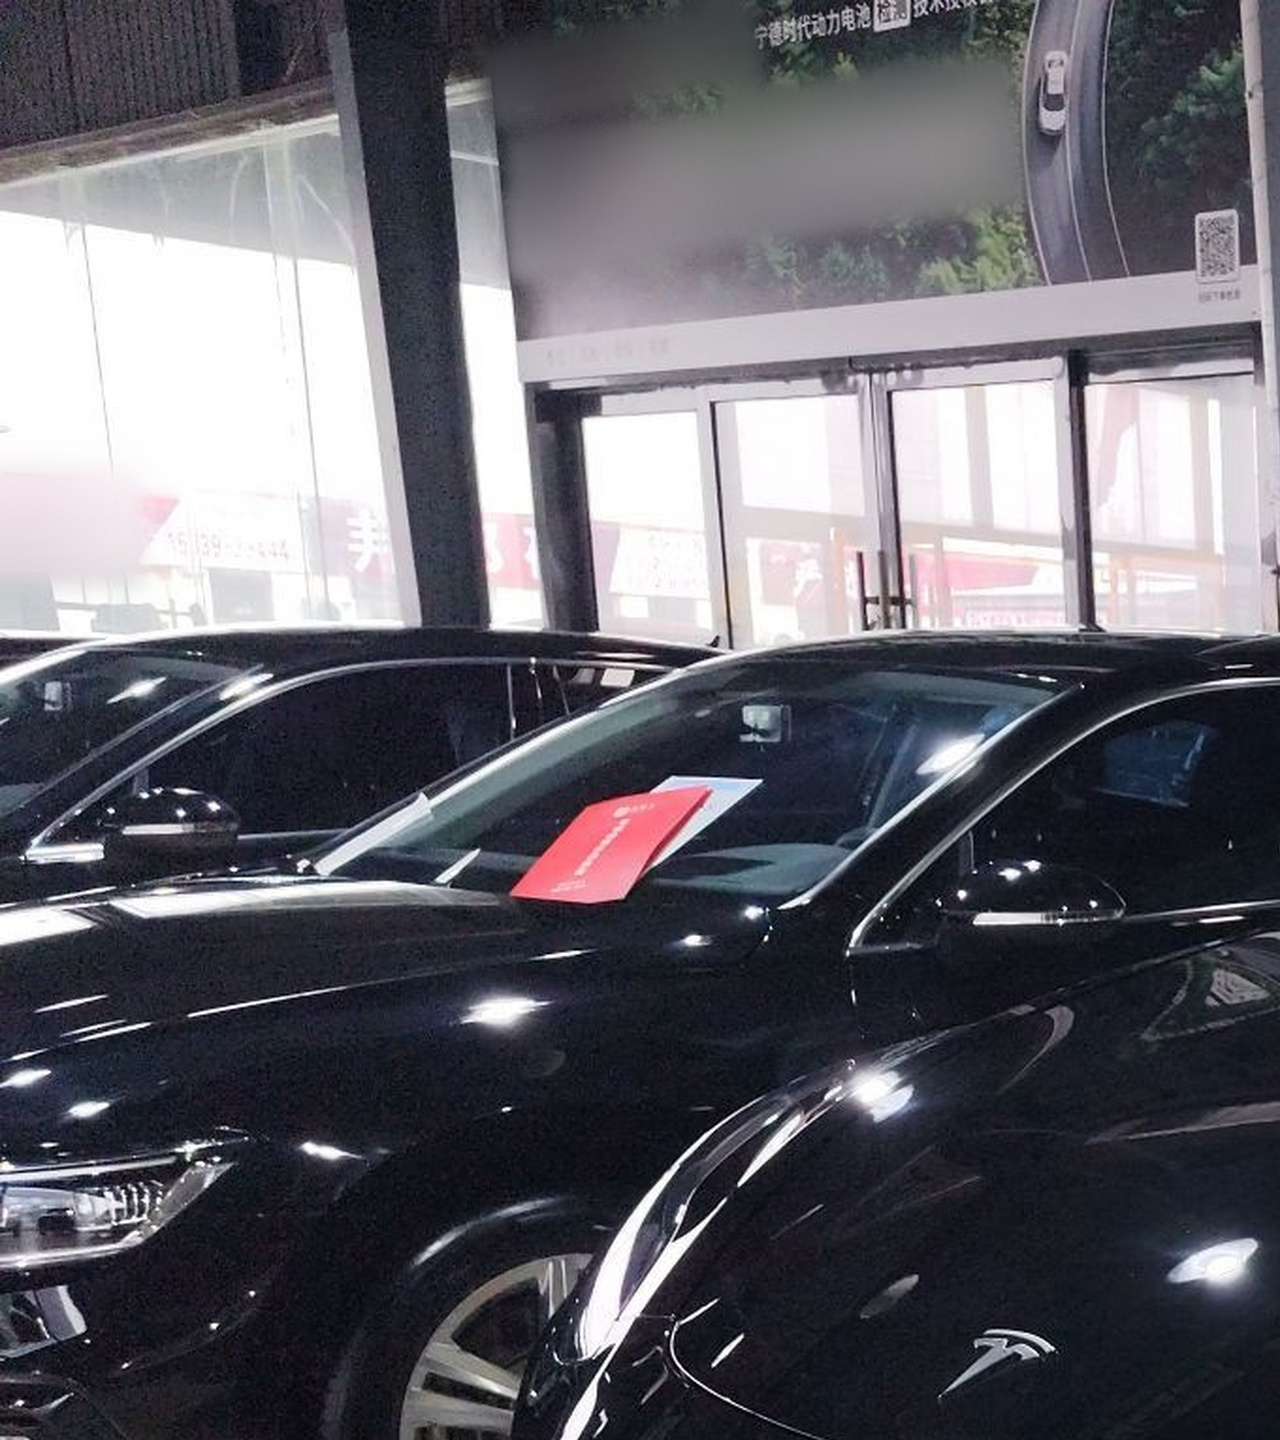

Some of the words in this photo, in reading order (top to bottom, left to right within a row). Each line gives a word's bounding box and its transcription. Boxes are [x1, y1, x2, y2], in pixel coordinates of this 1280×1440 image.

[755, 3, 872, 50] 宁德时代动力电池
